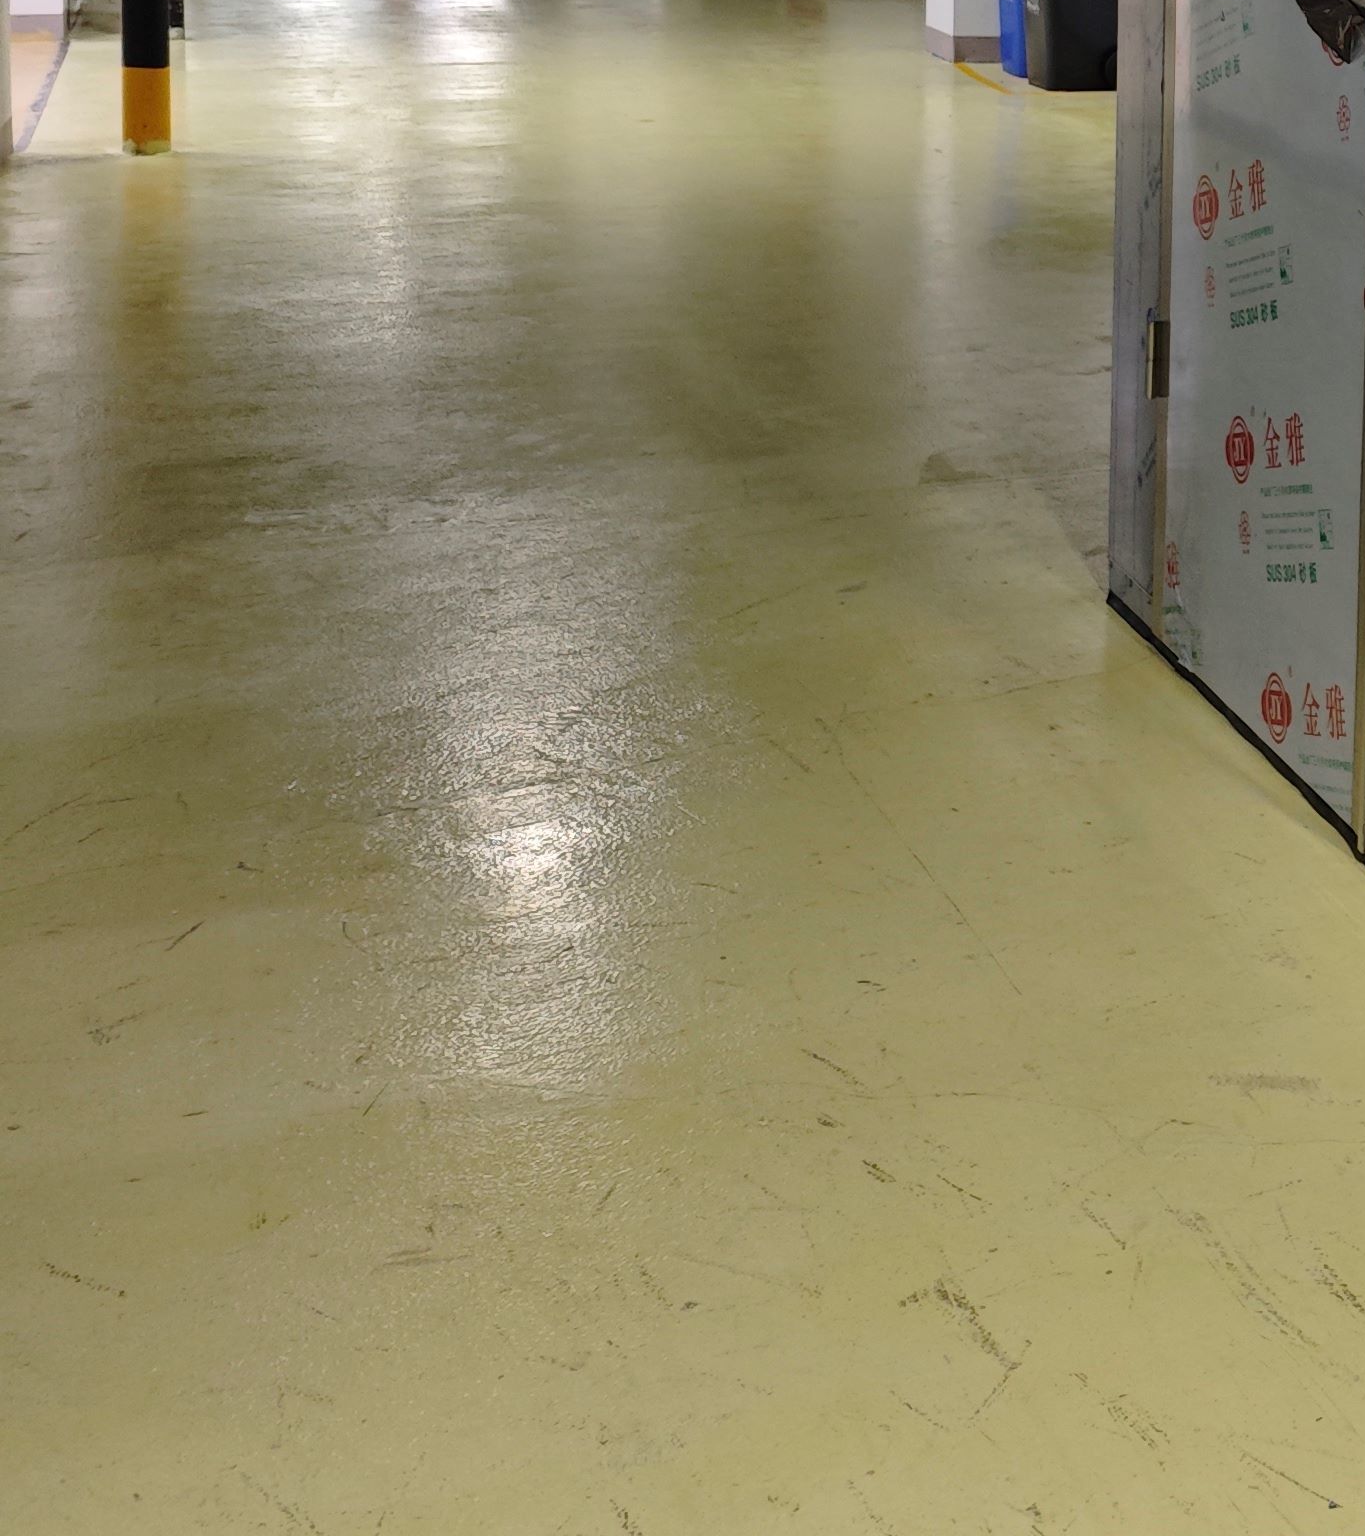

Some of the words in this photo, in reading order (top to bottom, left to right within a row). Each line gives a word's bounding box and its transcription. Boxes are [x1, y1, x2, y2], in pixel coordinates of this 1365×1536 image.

[1228, 159, 1267, 221] 金雅
[1262, 413, 1306, 470] 金雅
[1266, 563, 1283, 583] SUS
[1284, 563, 1297, 583] 304
[1301, 682, 1347, 741] 金雅
